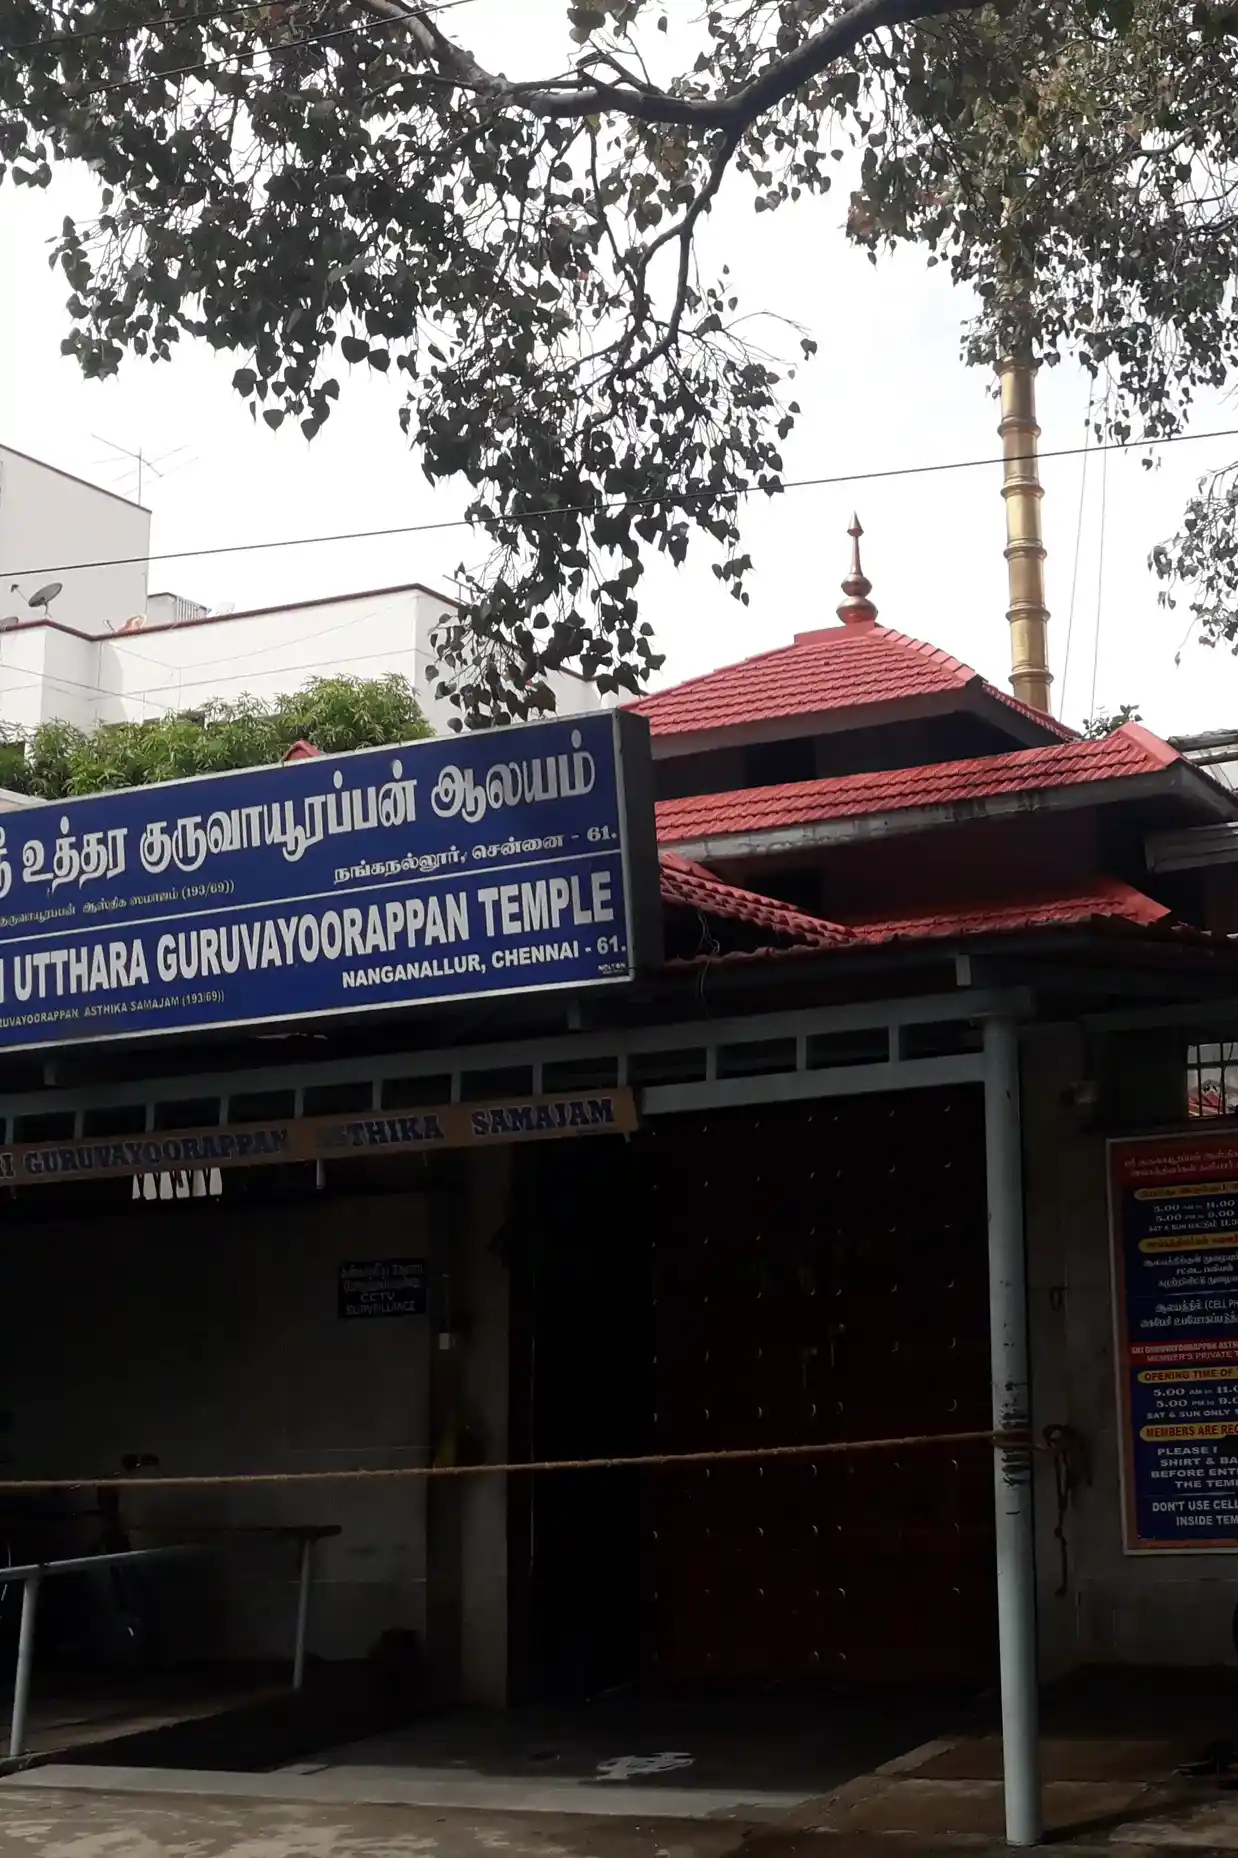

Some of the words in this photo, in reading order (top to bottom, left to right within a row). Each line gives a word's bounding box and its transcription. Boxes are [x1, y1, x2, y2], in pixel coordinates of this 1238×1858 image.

[22, 815, 129, 894] உத்தர
[140, 758, 417, 874] குருவாயூரப்பன்
[430, 729, 596, 824] ஆலயம்
[471, 834, 564, 860] சென்னை
[587, 825, 618, 843] 61.
[13, 938, 149, 1002] UTTHARA
[157, 891, 470, 984] GURUVAYOORAPPAN
[477, 870, 615, 938] TEMPLE
[342, 953, 487, 988] NANGANALLUR,
[491, 939, 579, 968] CHENNAI
[597, 935, 627, 955] 61.
[84, 1000, 128, 1017] ASTHIKA
[131, 995, 180, 1013] SAMAJAM
[23, 1129, 288, 1177] GURUVAYOORAPPAN
[471, 1097, 615, 1136] SAMAJAM
[360, 1291, 396, 1304] CCTV
[1195, 1350, 1233, 1360] PRIVATE
[1144, 1370, 1190, 1381] OPENING
[1193, 1368, 1219, 1379] TIME
[1221, 1367, 1233, 1377] OF
[1153, 1387, 1185, 1397] 5.00
[1156, 1398, 1188, 1408] 5.00
[1146, 1411, 1166, 1419] SAT
[1179, 1408, 1201, 1418] SUN
[1203, 1407, 1231, 1417] ONLY
[1146, 1425, 1195, 1437] MEMBERS
[1199, 1424, 1217, 1436] ARE
[1157, 1446, 1209, 1456] PLEASE
[1160, 1457, 1202, 1468] SHIRT
[1205, 1457, 1216, 1466] &
[1150, 1468, 1205, 1479] BEFORE
[1174, 1479, 1202, 1489] THE
[1152, 1500, 1186, 1513] DON'T
[1188, 1499, 1211, 1511] USE
[1176, 1515, 1213, 1527] INSIDE
